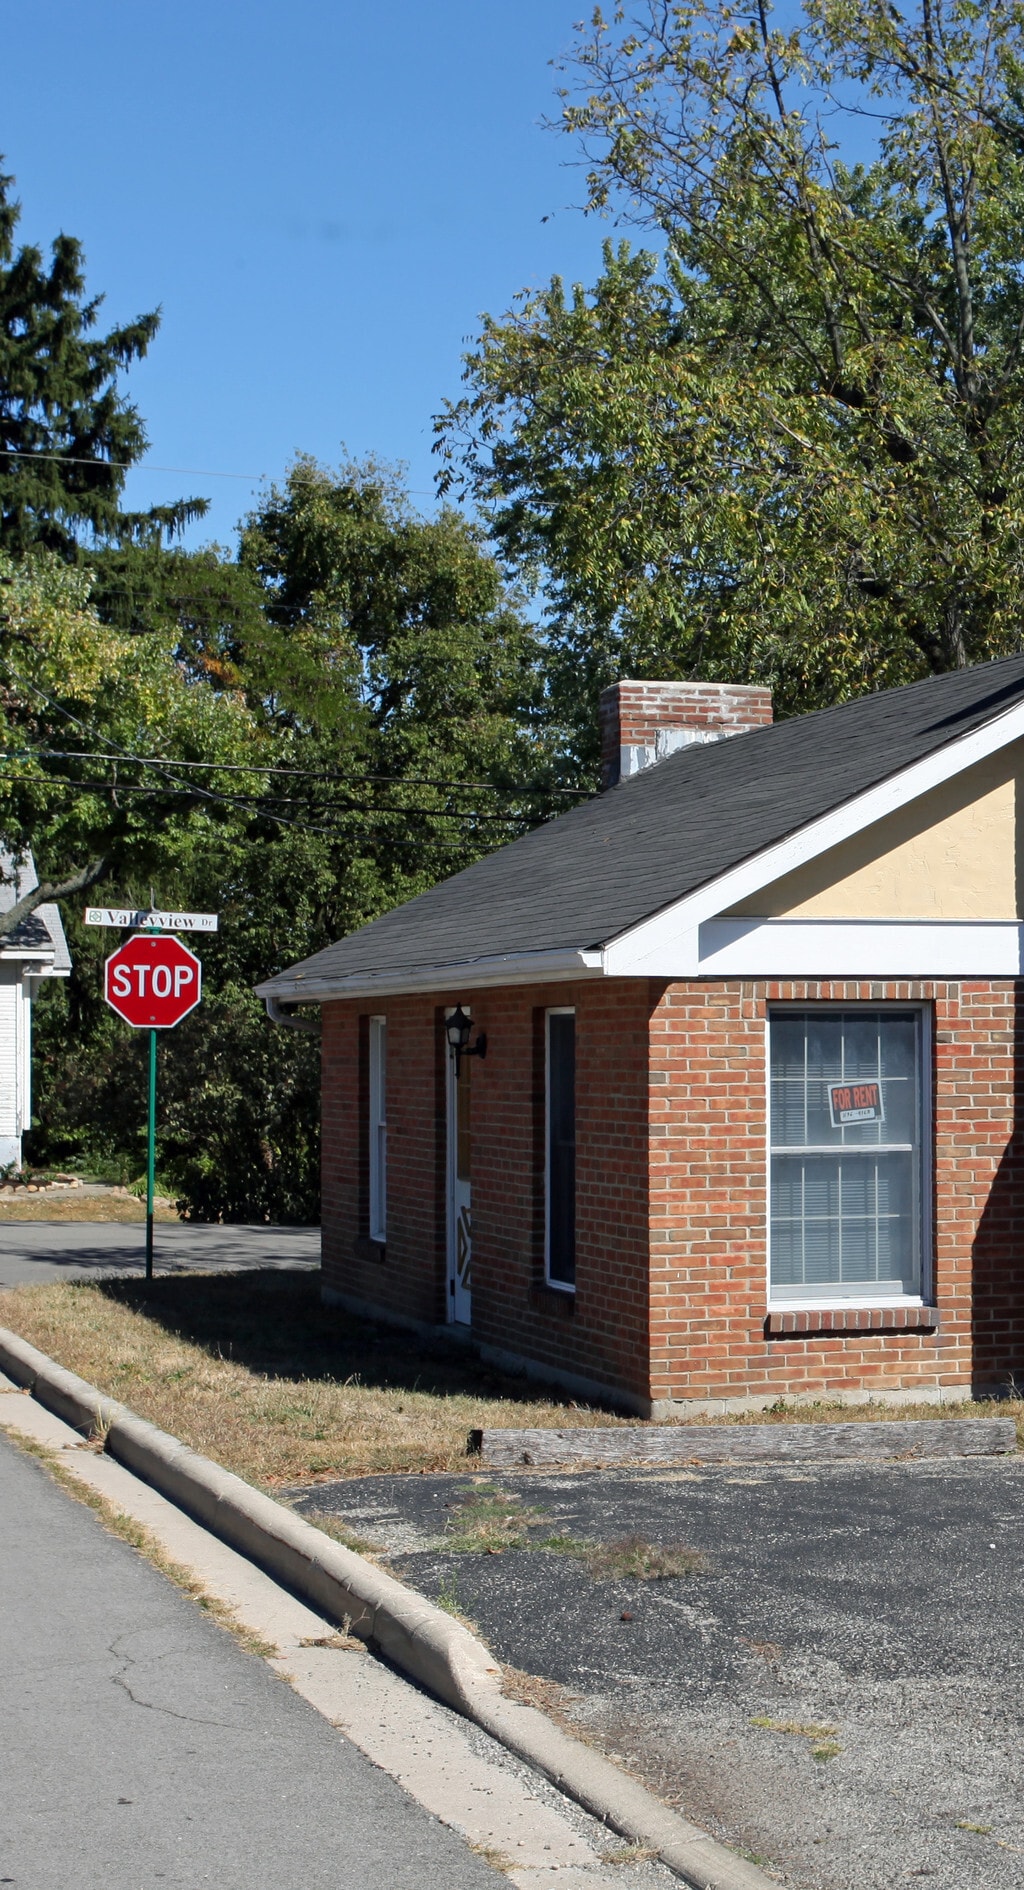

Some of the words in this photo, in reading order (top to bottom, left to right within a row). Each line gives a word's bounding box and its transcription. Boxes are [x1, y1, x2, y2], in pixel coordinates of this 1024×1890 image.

[107, 911, 196, 928] Valleyview
[201, 918, 213, 927] Dr
[112, 964, 194, 998] STOP
[832, 1087, 852, 1111] FOR
[853, 1084, 878, 1108] RENT
